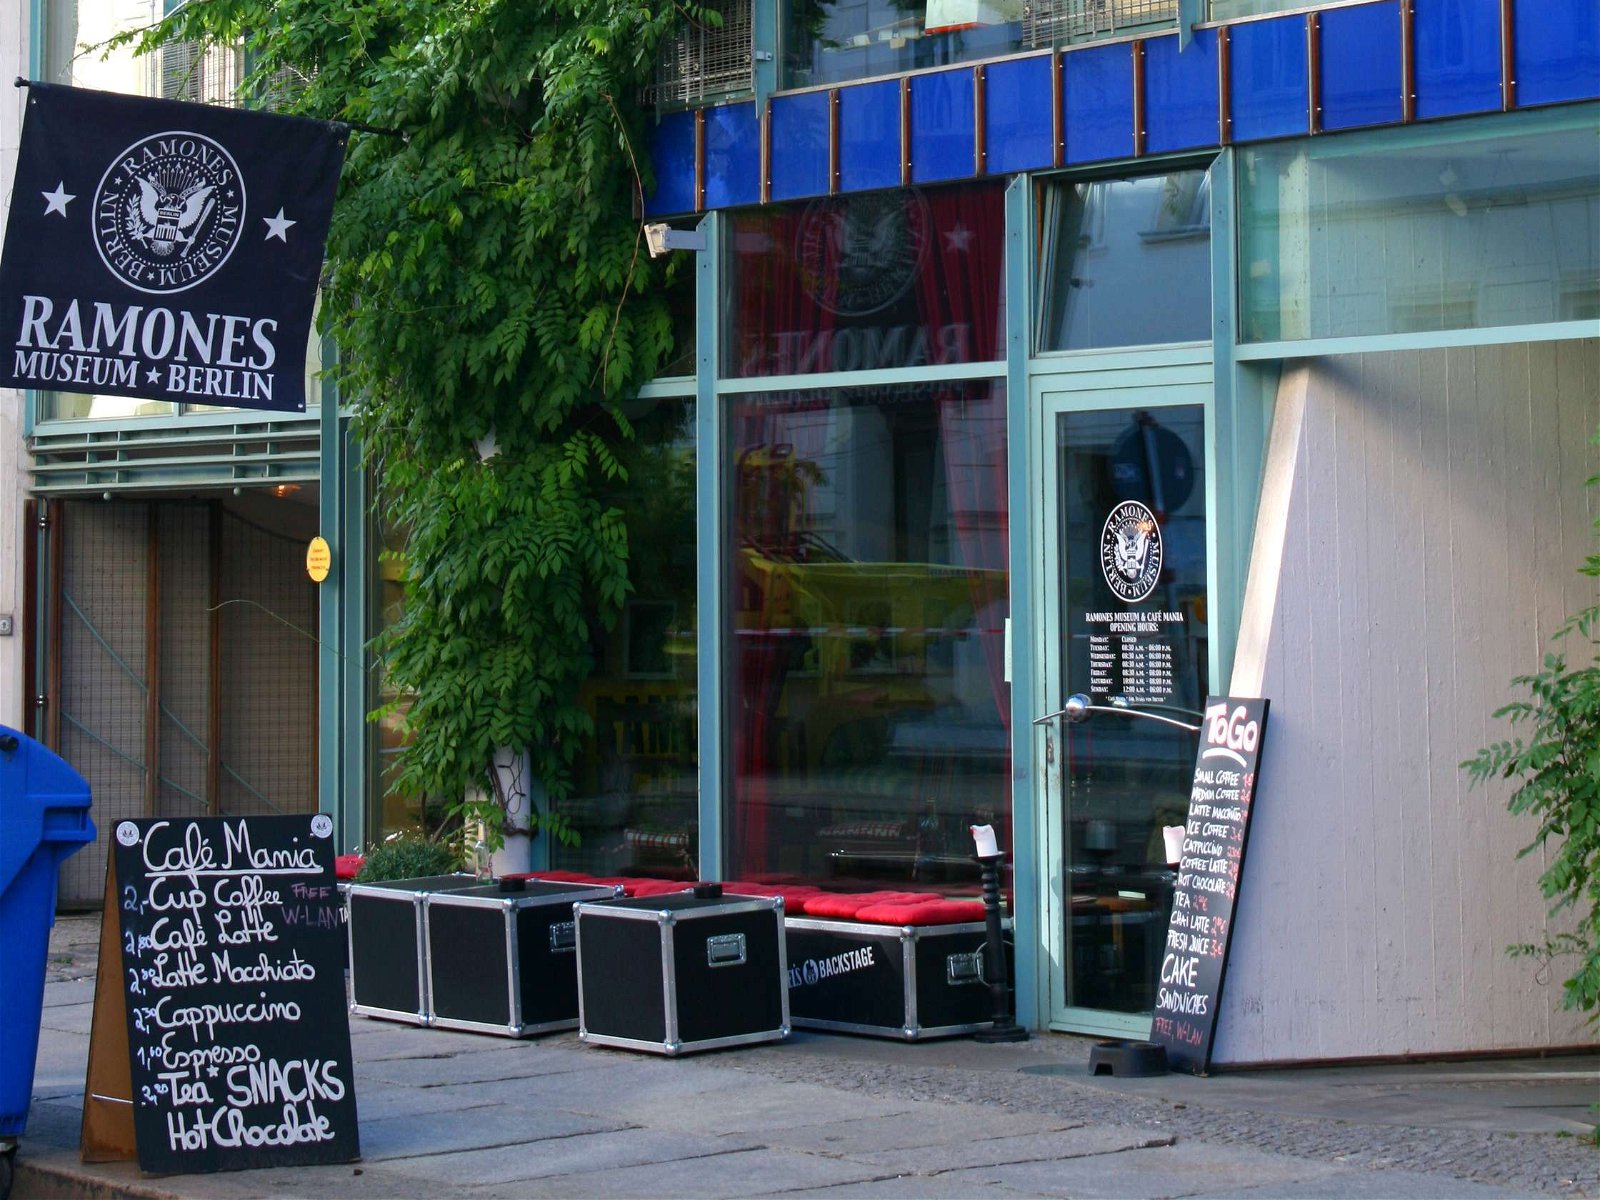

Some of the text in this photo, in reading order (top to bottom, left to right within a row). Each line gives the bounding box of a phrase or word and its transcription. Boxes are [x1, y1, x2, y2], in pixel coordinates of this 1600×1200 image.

[120, 138, 234, 186] RAMONES
[100, 190, 147, 281] BERLIN
[157, 204, 239, 286] MUSEUM
[15, 294, 279, 371] RAMONES
[12, 350, 275, 400] MUSEUM BERLIN
[1107, 505, 1154, 533] RAMONES
[1103, 543, 1127, 596] BERLIN
[1132, 541, 1160, 597] MUSEUM
[1085, 612, 1114, 622] RAMONES
[1114, 612, 1140, 622] MUSEUM
[1147, 609, 1162, 622] CAFÉ
[1163, 612, 1184, 622] MANIA
[1109, 622, 1136, 632] OPENING
[1194, 768, 1215, 785] SMALL
[1215, 770, 1240, 786] COFFEE
[1189, 803, 1211, 817] LATTE
[1215, 788, 1240, 801] COFFEE
[1186, 819, 1201, 835] ICE
[1202, 822, 1230, 838] COFFEE
[142, 821, 217, 889] Café
[221, 818, 322, 869] Mania
[1180, 856, 1209, 871] COFFEE
[1208, 858, 1228, 874] LATTE
[149, 876, 207, 925] Cup
[213, 874, 283, 924] Coffee
[291, 882, 332, 899] FREE
[1175, 890, 1190, 909] TEA
[1178, 872, 1193, 887] HOT
[1192, 875, 1226, 894] CHOCOLATE
[281, 904, 338, 929] W-LAN
[1190, 915, 1210, 934] LATTE
[151, 917, 208, 961] Café
[214, 909, 279, 944] Latte
[1168, 929, 1188, 952] FRESH
[152, 952, 208, 988] Latte
[211, 948, 316, 984] Macchiato
[819, 946, 875, 978] BACKSTAGE
[1161, 953, 1199, 987] CAKE
[155, 991, 301, 1043] Cappuccino
[161, 1031, 261, 1079] Espresso
[157, 1071, 214, 1106] Tea
[226, 1057, 346, 1107] SNACKS
[167, 1099, 336, 1151] Hot Chocolate
